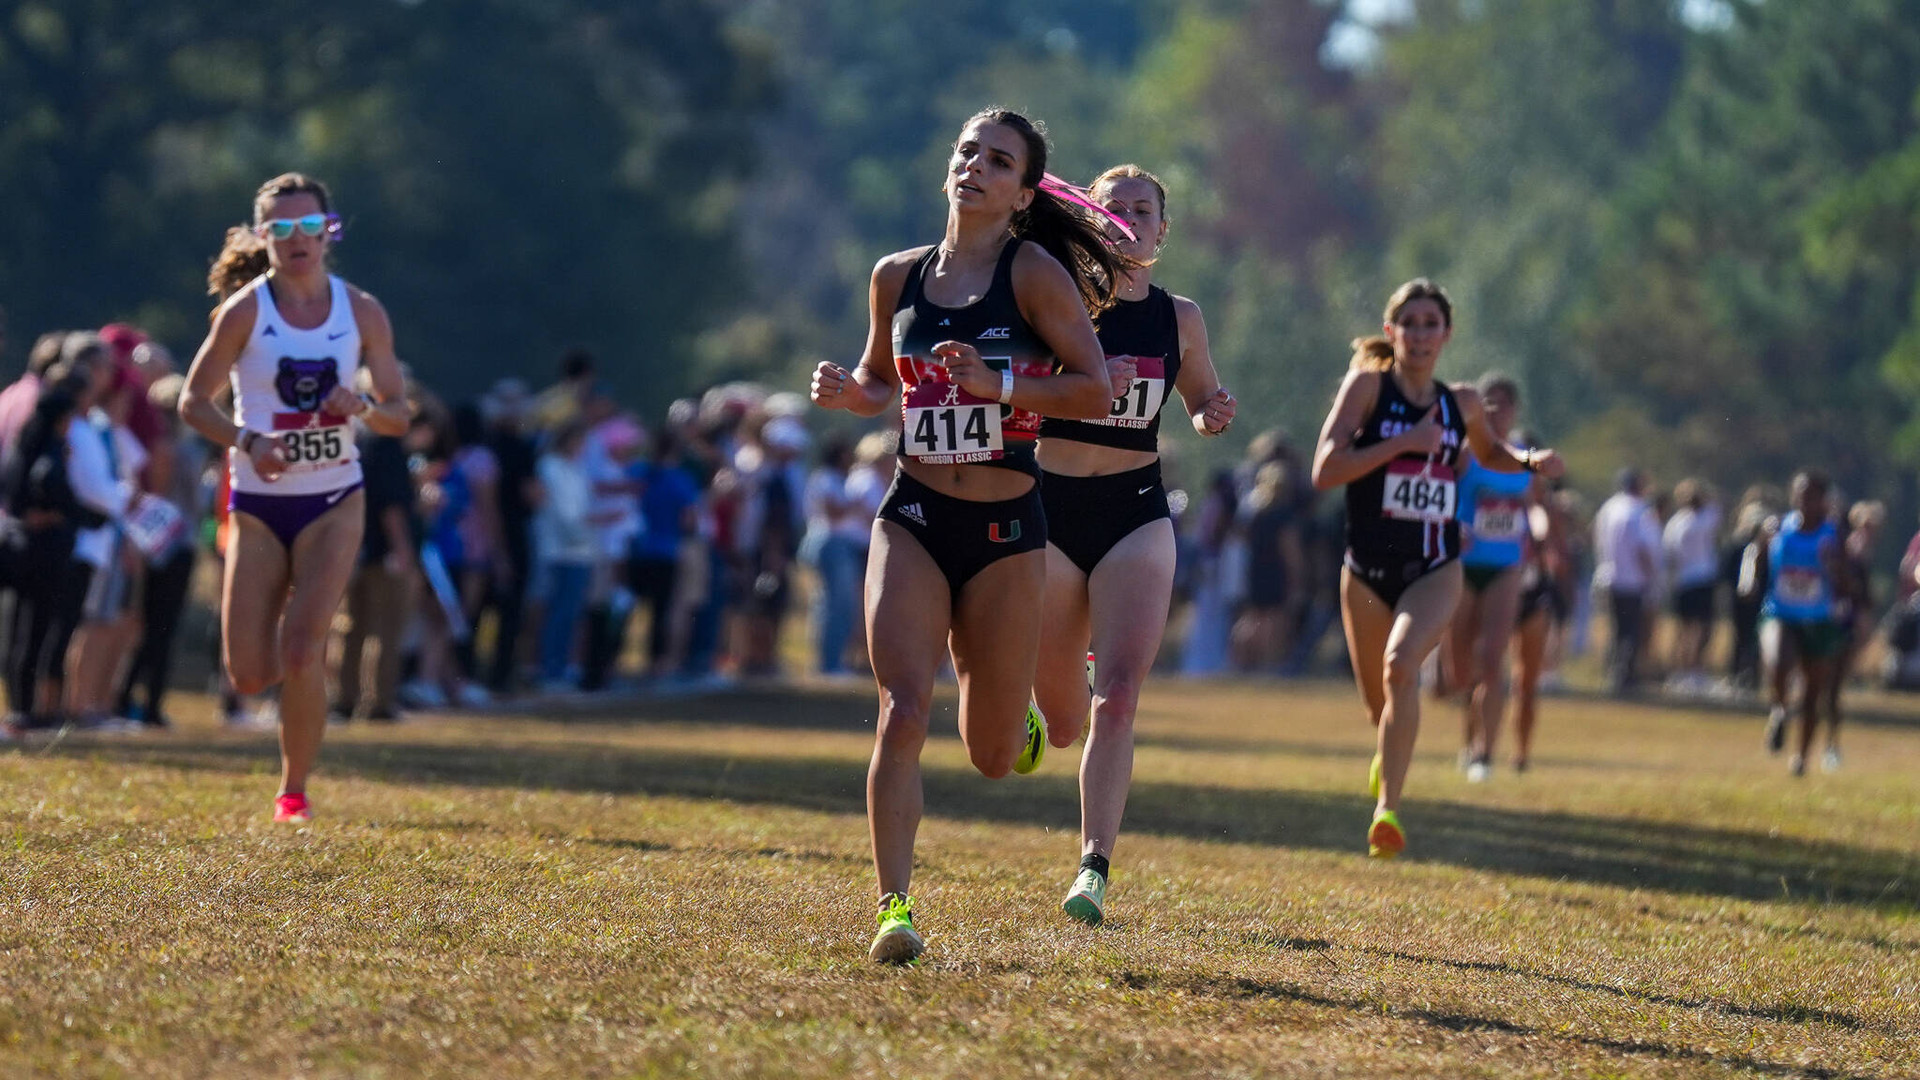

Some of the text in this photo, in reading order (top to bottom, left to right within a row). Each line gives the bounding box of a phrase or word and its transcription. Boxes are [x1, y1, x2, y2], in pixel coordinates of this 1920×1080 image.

[979, 327, 1011, 338] ACC
[938, 384, 960, 406] A
[1110, 380, 1149, 418] 31
[914, 407, 991, 452] 414
[1117, 419, 1151, 430] CLASSIC
[284, 428, 341, 463] 355
[918, 451, 992, 465] CRIMSON CLASSIC
[1394, 478, 1447, 512] 464
[897, 506, 927, 527] adidas
[988, 519, 1021, 543] U
